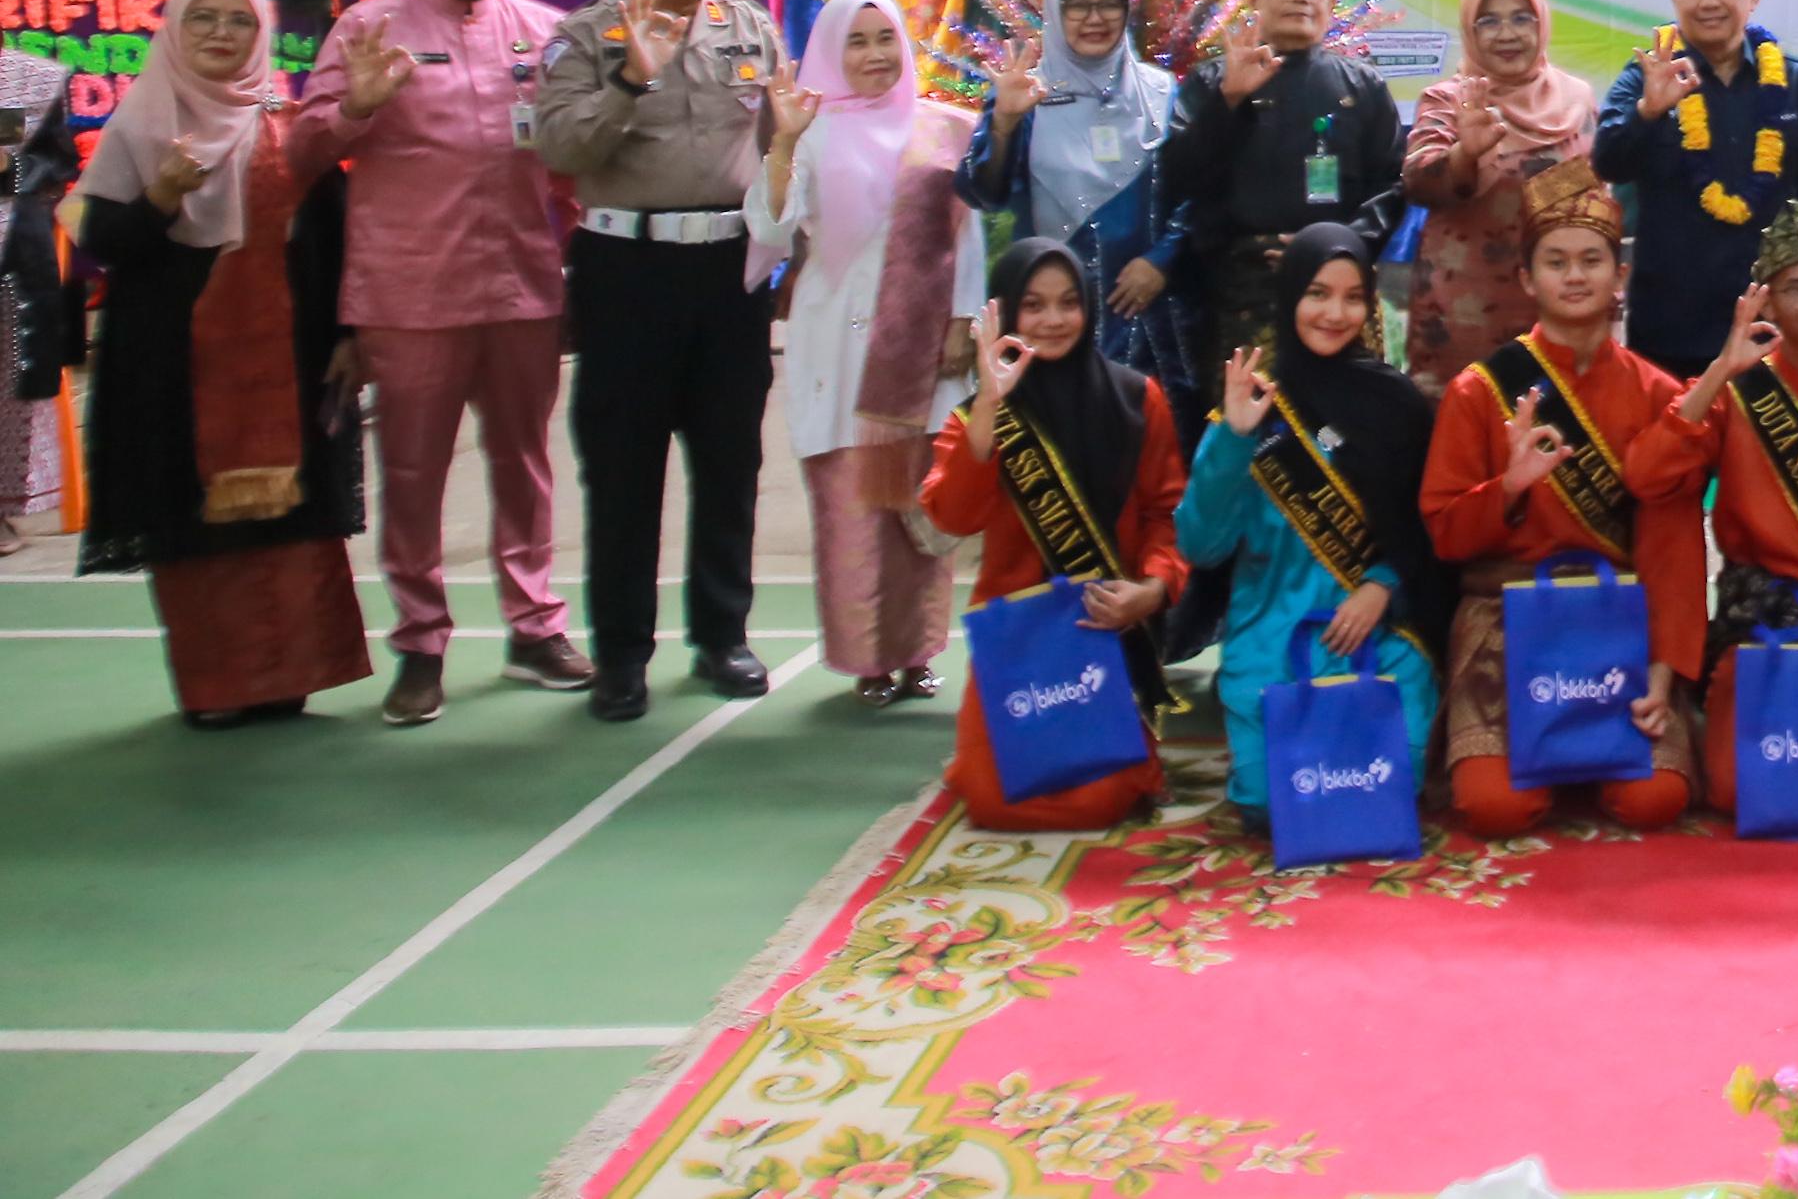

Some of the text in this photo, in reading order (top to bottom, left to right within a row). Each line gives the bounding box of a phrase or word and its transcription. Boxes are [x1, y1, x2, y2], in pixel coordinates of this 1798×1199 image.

[1259, 455, 1293, 496] DUTA
[1004, 448, 1050, 494] SSK
[1027, 490, 1086, 555] SMAN
[1308, 484, 1367, 549] JUARA
[1034, 681, 1088, 709] bkkbn
[1559, 679, 1609, 700] bkkbn
